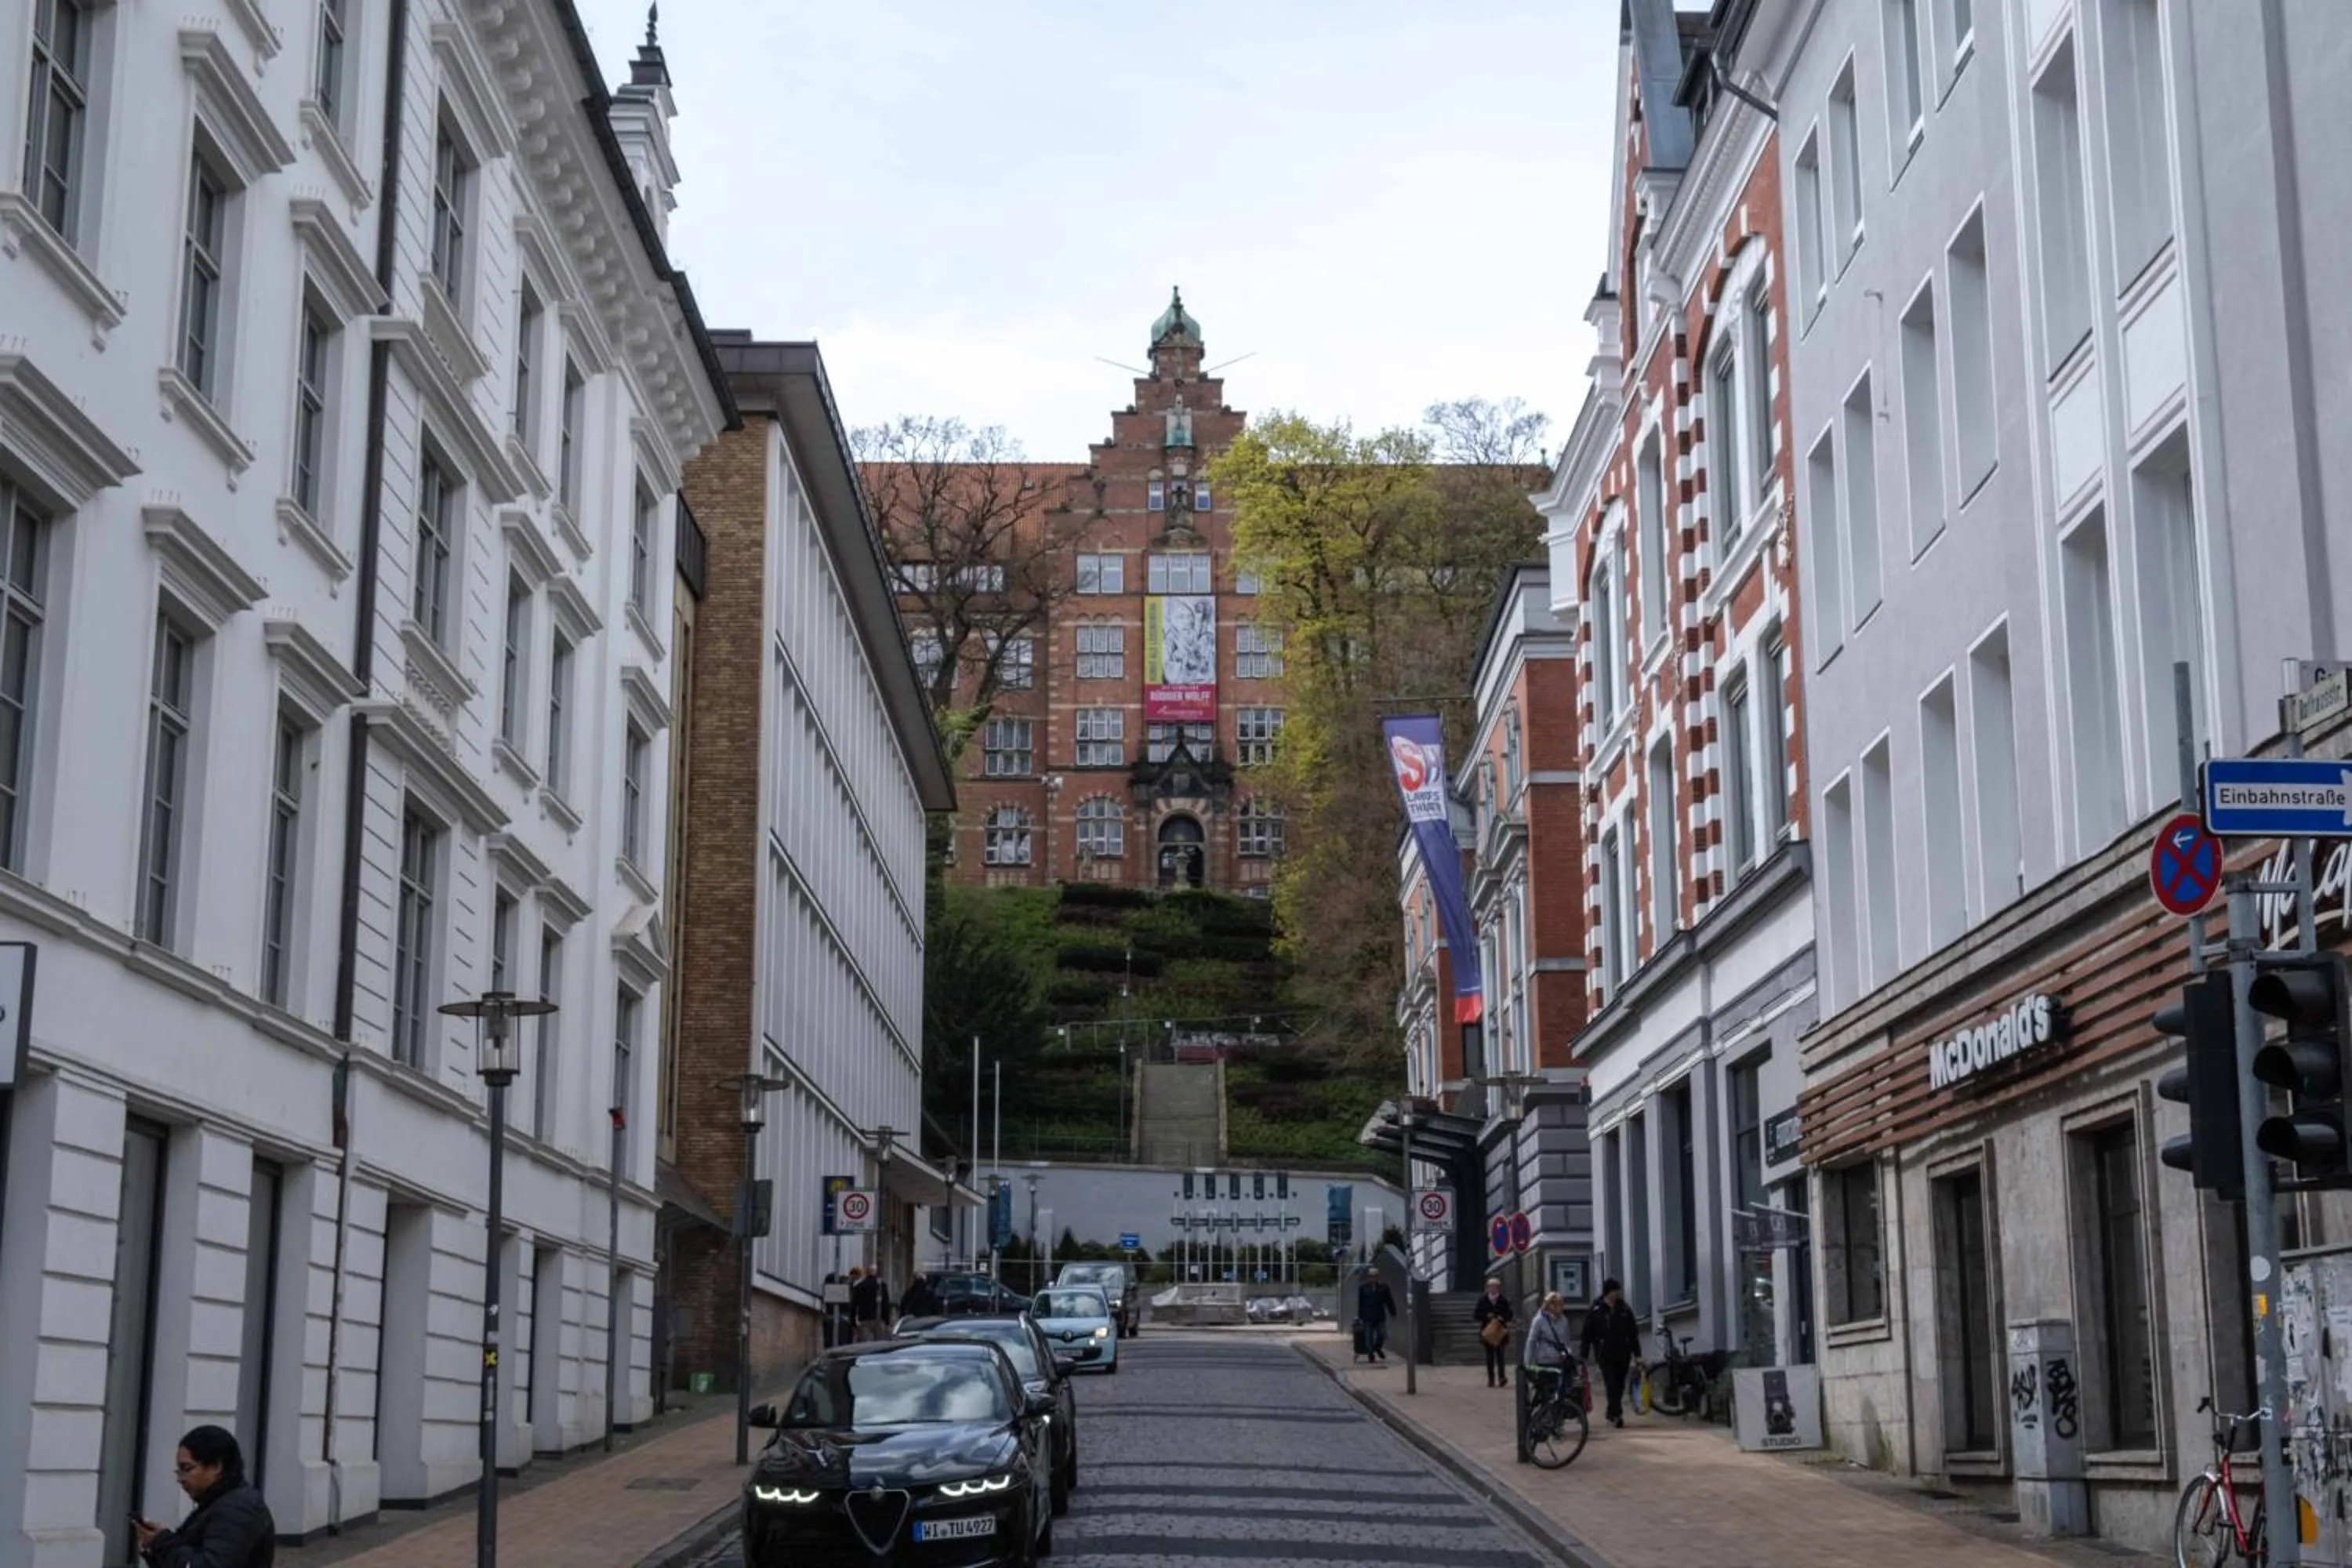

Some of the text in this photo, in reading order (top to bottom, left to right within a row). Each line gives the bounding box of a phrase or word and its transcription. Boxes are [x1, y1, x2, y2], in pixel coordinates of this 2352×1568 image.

[2220, 787, 2346, 806] Einbahnstraße
[1929, 993, 2051, 1091] McDonald's
[850, 1200, 864, 1212] 30
[1426, 1200, 1440, 1213] 30
[1761, 1436, 1802, 1448] STUDIO
